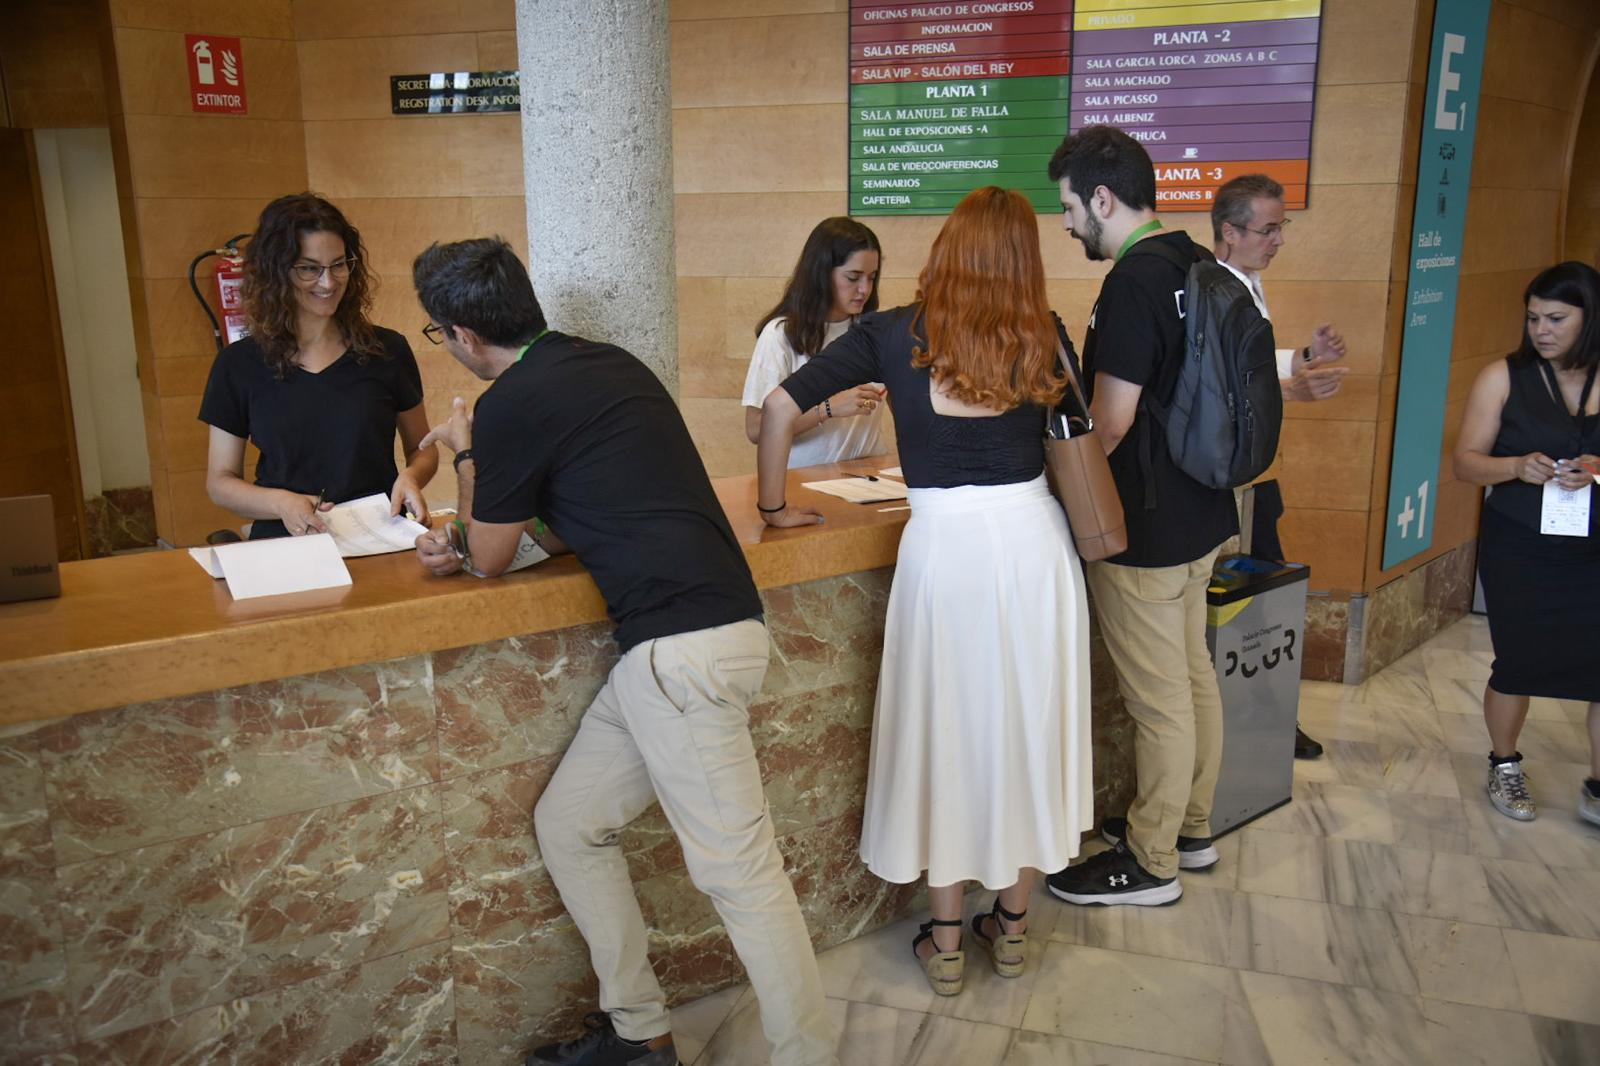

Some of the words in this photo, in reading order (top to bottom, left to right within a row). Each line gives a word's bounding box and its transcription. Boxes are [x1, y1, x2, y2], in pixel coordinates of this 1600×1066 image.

[864, 10, 908, 20] OFICINAS
[912, 8, 950, 18] PALACIO
[955, 6, 968, 16] DE
[972, 2, 1034, 14] CONGRESOS
[1088, 14, 1135, 26] PRIVADO
[922, 22, 992, 35] INFORMACION
[1154, 30, 1208, 45] PLANTA
[1214, 29, 1230, 42] -2
[863, 46, 892, 58] SALA
[894, 44, 908, 55] DE
[912, 42, 956, 54] PRENSA
[1086, 59, 1112, 70] SALA
[1116, 56, 1156, 68] GARCIA
[1159, 55, 1196, 66] LORCA
[1204, 53, 1242, 64] ZONAS
[1245, 52, 1254, 62] A
[1258, 52, 1265, 61] B
[1268, 50, 1278, 60] C
[862, 68, 892, 80] SALA
[893, 67, 911, 78] VIP
[921, 64, 960, 77] SALÓN
[964, 64, 986, 76] DEL
[990, 62, 1014, 74] REY
[1084, 77, 1110, 88] SALA
[1114, 75, 1170, 86] MACHADO
[926, 86, 976, 98] PLANTA
[980, 85, 988, 96] 1
[196, 93, 242, 108] EXTINTOR
[400, 96, 462, 108] REGISTRATION
[466, 96, 490, 106] DESK
[1084, 96, 1110, 106] SALA
[1114, 94, 1158, 105] PICASSO
[860, 109, 892, 120] SALA
[896, 108, 947, 120] MANUEL
[952, 107, 967, 118] DE
[972, 105, 1009, 117] FALLA
[1084, 114, 1109, 124] SALA
[1112, 112, 1154, 124] ALBENIZ
[863, 127, 886, 136] HALL
[888, 127, 902, 136] DE
[904, 125, 973, 136] EXPOSICIONES
[976, 125, 988, 134] -A
[863, 145, 886, 154] SALA
[889, 143, 944, 154] ANDALUCIA
[862, 162, 886, 172] SALA
[888, 162, 899, 170] DE
[902, 160, 998, 170] VIDEOCONFERENCIAS
[1206, 168, 1222, 180] -3
[863, 178, 920, 188] SEMINARIOS
[862, 196, 910, 205] CAFETERIA
[1205, 191, 1212, 199] B
[1418, 232, 1432, 247] Hall
[1433, 231, 1442, 246] de
[1416, 253, 1456, 272] exposiciones
[1396, 480, 1428, 539] +1
